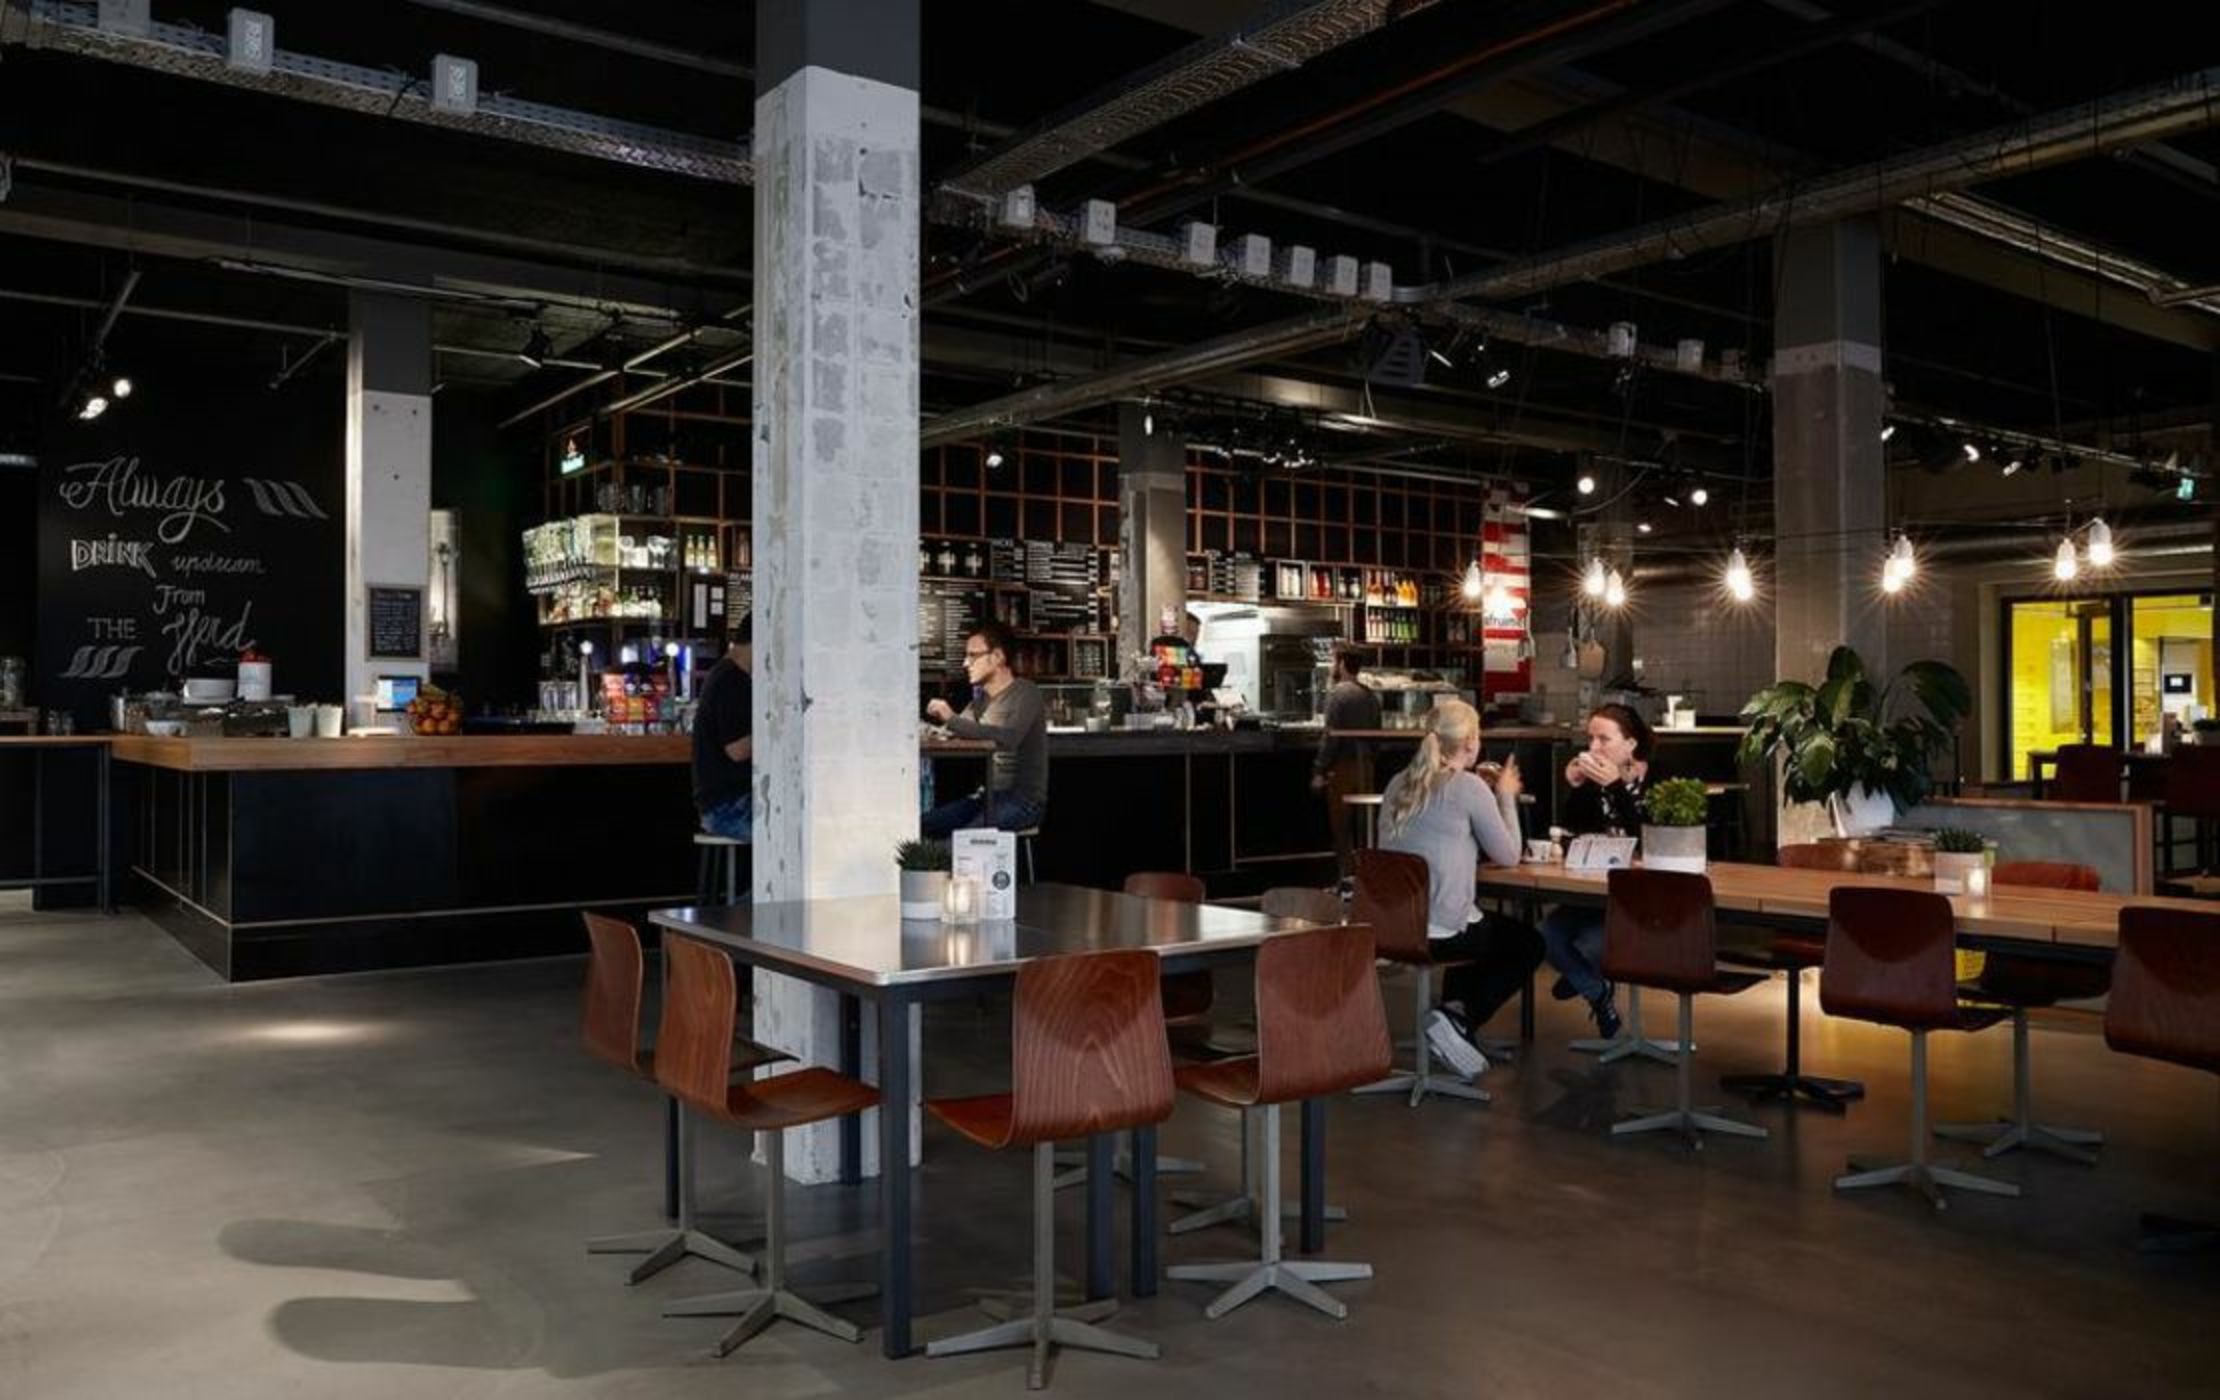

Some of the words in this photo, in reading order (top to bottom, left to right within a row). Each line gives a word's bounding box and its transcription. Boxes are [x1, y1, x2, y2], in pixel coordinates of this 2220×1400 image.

[60, 456, 231, 543] Always
[153, 585, 205, 614] From
[87, 617, 137, 639] THE
